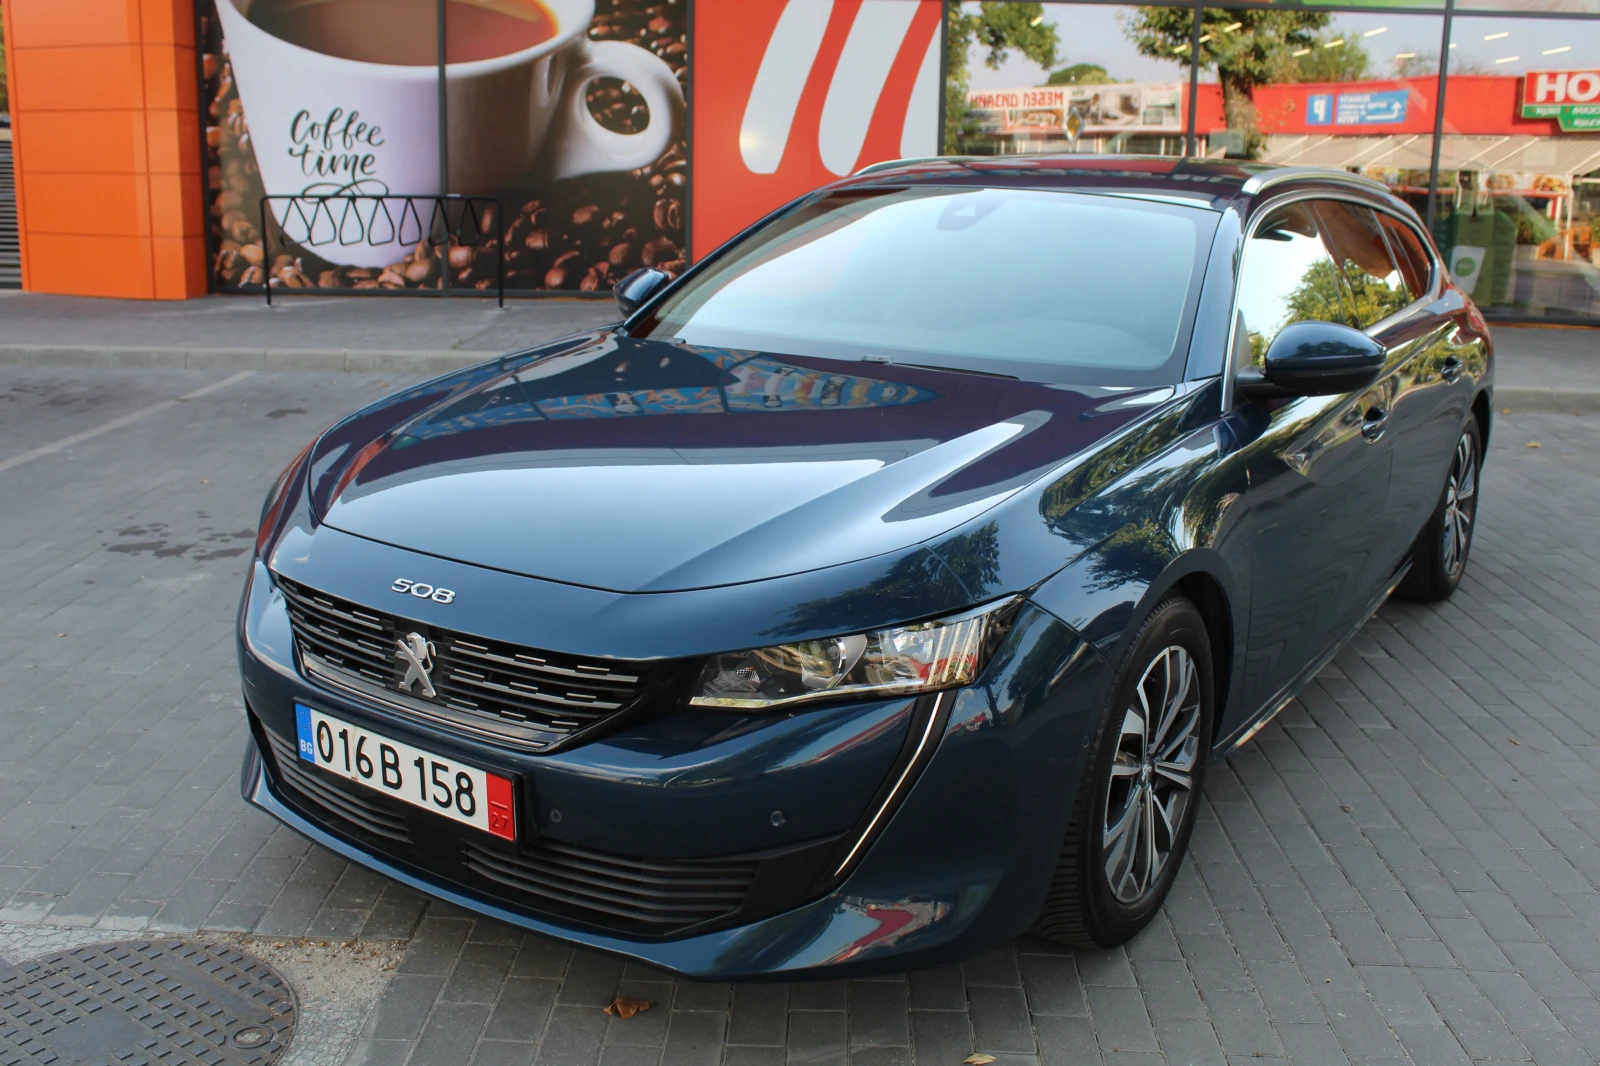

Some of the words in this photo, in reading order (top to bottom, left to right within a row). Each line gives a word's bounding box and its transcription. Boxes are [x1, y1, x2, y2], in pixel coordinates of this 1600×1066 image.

[290, 107, 385, 151] Coffee
[288, 143, 377, 184] time
[391, 577, 456, 604] 508
[300, 738, 313, 755] BG
[492, 812, 508, 829] 27
